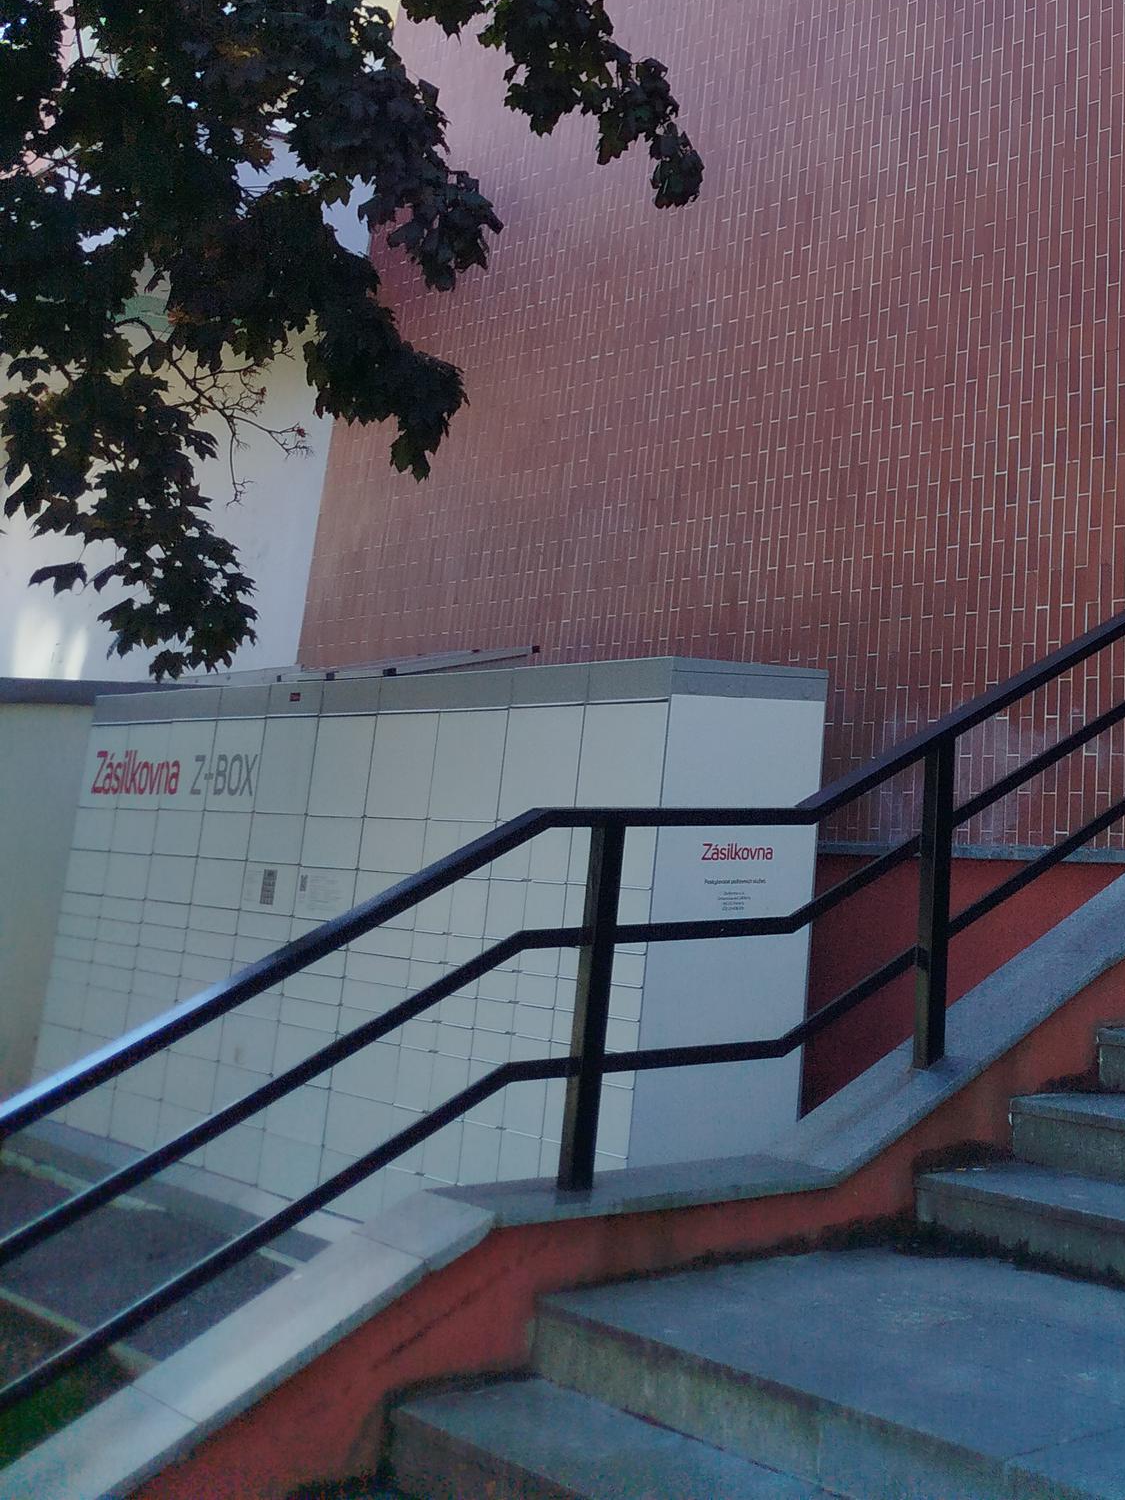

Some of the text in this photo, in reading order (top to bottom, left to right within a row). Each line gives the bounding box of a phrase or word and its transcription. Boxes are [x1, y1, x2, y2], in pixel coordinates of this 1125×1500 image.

[91, 750, 258, 797] Zásilkovna Z-BOX
[701, 843, 774, 861] Zásilkovna
